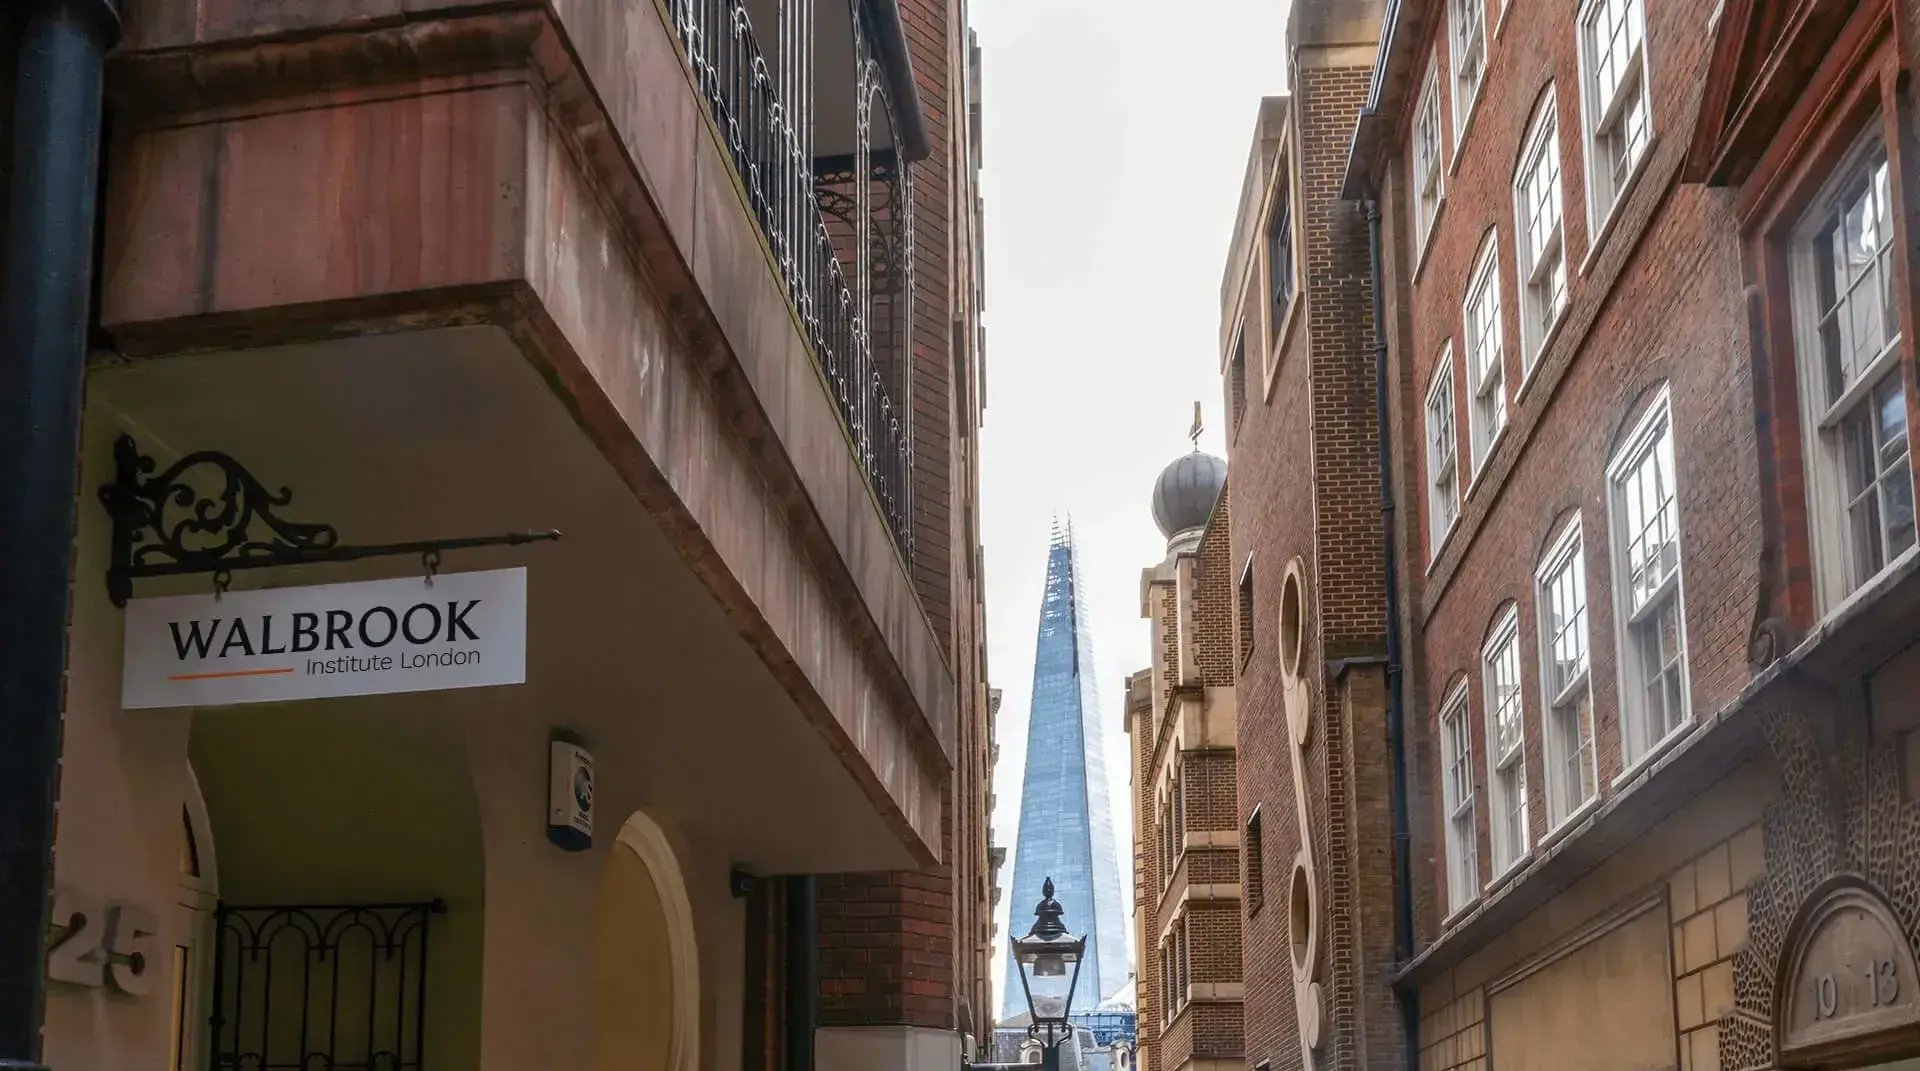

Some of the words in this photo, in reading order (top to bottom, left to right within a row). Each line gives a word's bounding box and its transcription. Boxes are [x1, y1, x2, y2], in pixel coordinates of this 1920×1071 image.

[168, 599, 482, 661] WALBROOK
[306, 652, 393, 676] Institute
[400, 648, 481, 670] London
[48, 890, 156, 996] 25
[1810, 972, 1838, 1021] 10
[1865, 956, 1899, 1007] 13
